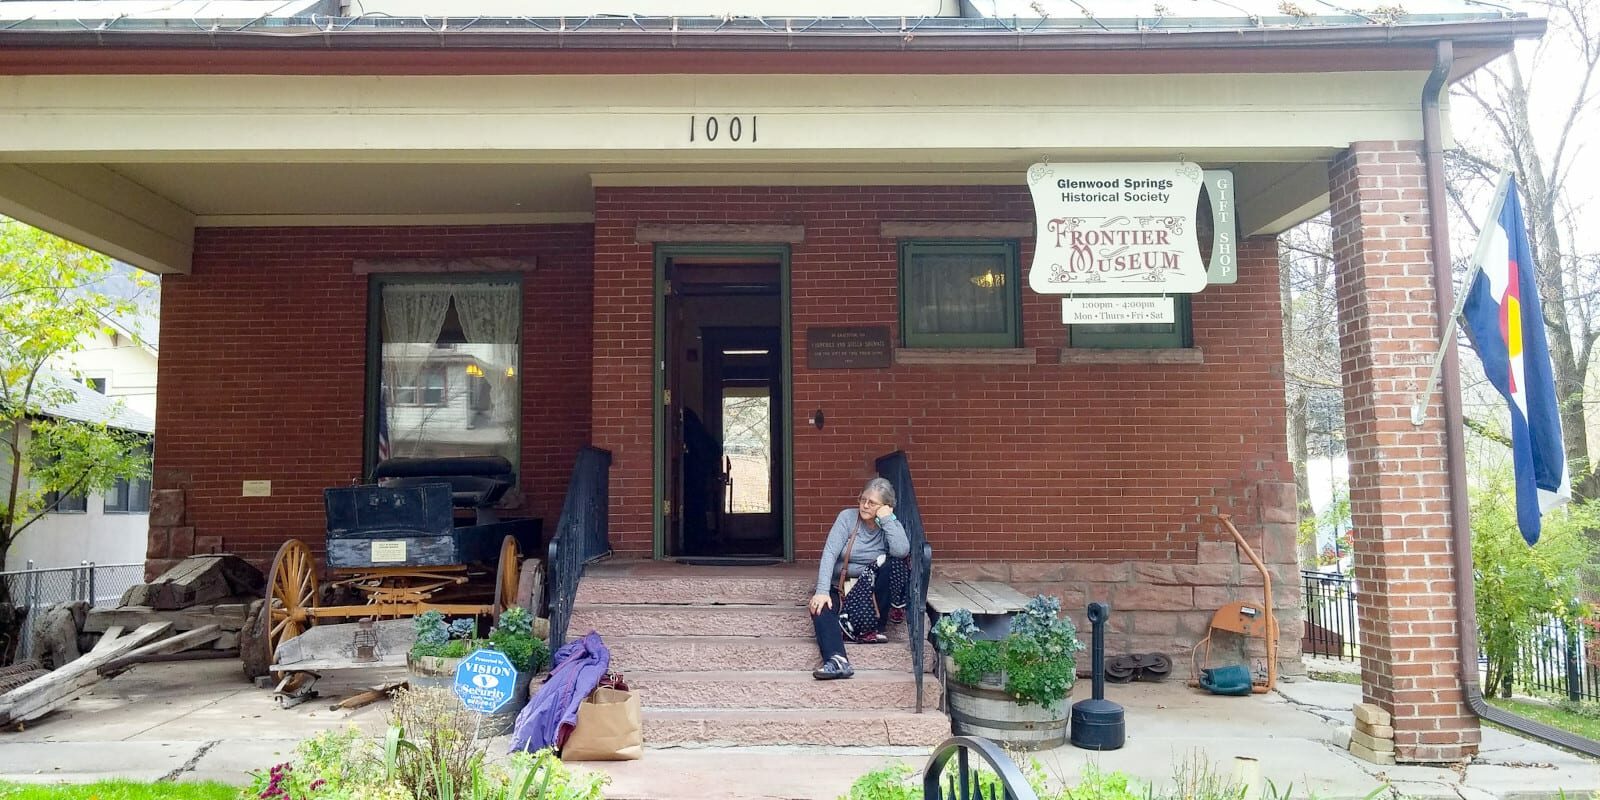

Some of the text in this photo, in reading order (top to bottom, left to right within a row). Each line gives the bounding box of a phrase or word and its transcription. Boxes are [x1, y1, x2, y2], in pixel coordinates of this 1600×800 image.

[690, 115, 757, 143] 1001
[1057, 178, 1173, 191] Glenwood Springs
[1061, 192, 1170, 204] Historical Society
[1047, 218, 1171, 248] FRONTIER
[1216, 178, 1231, 277] GIFT SHOP
[1070, 244, 1181, 274] MUSEUM
[1082, 301, 1113, 309] 1:00pm
[1122, 301, 1155, 309] 4:00pm
[1074, 311, 1163, 320] Mon Thurs Fri Sat
[465, 662, 511, 677] VISION
[462, 684, 505, 700] Security
